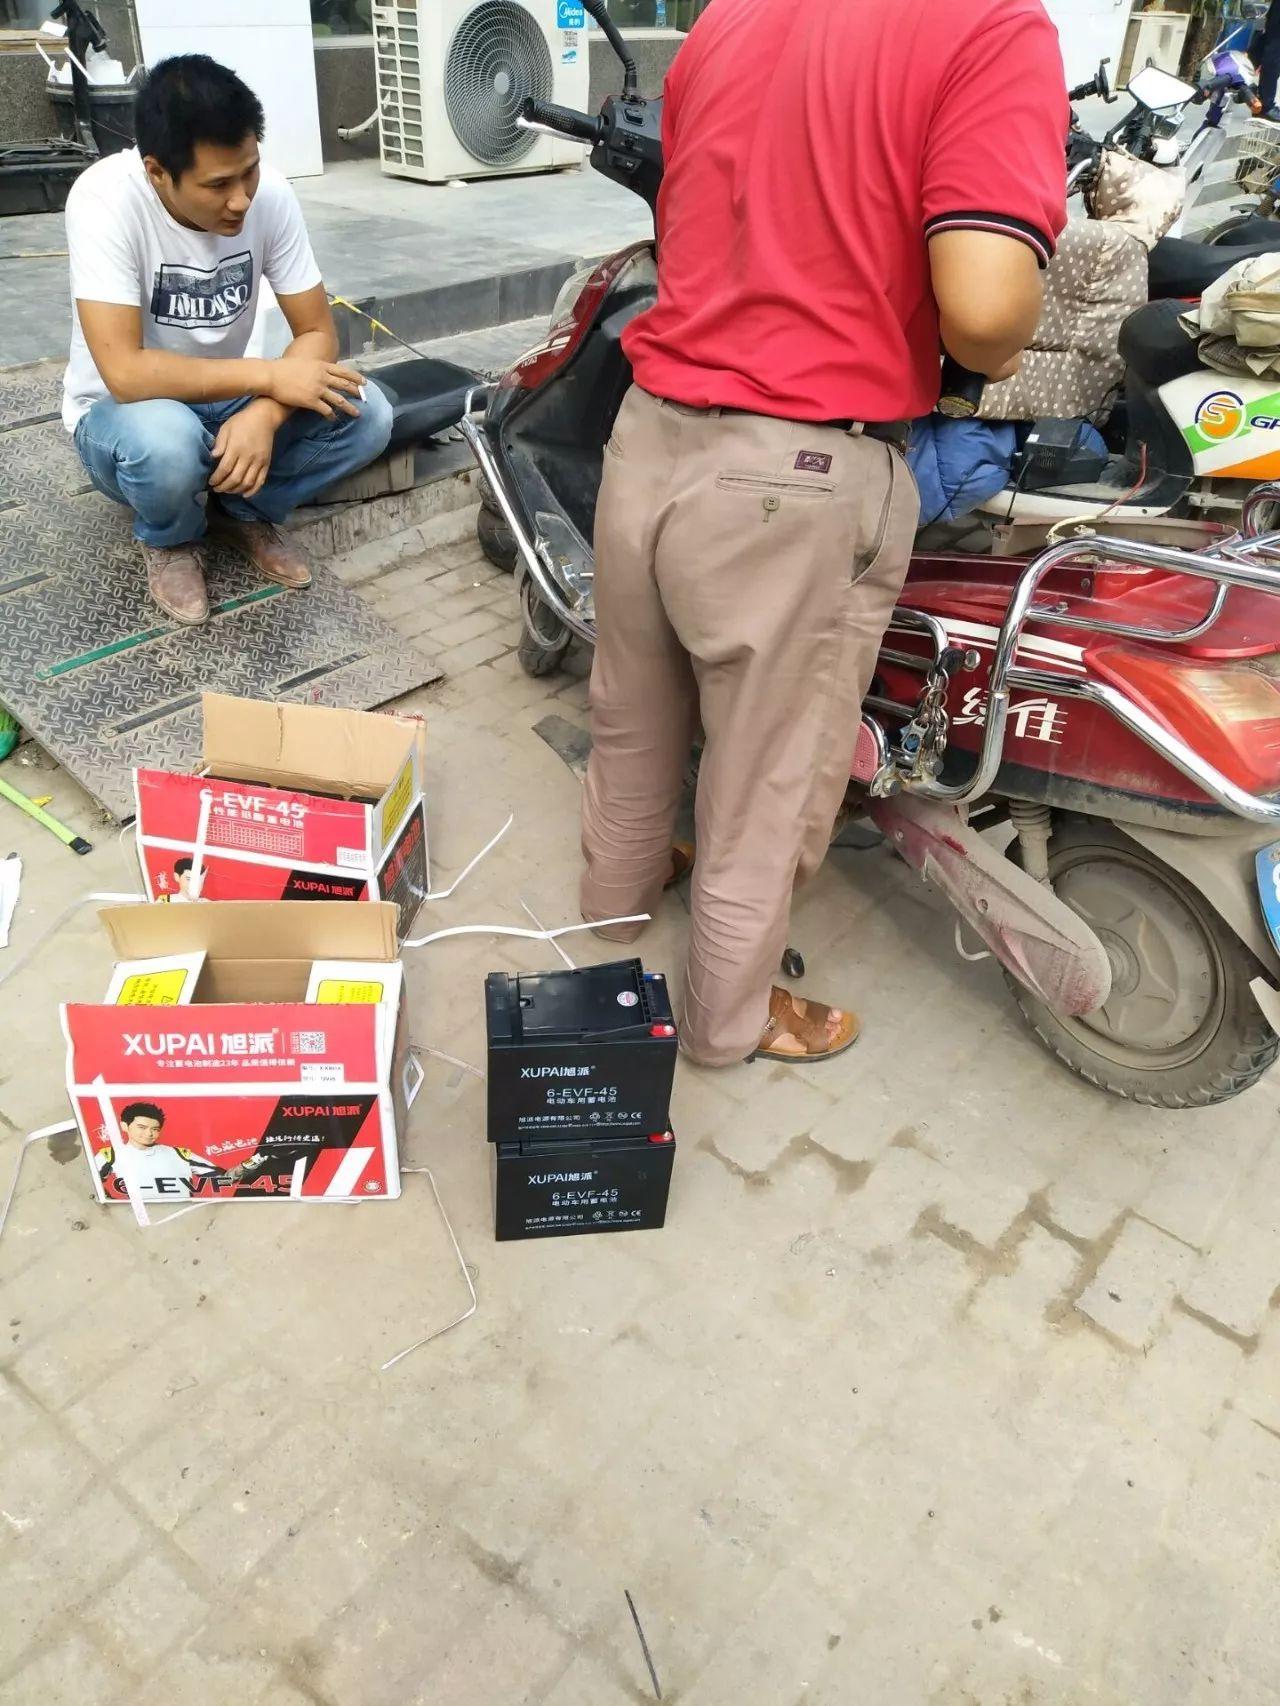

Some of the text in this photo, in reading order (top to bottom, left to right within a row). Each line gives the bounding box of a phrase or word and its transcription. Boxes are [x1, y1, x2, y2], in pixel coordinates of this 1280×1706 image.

[294, 880, 330, 893] XUPAI
[121, 1033, 275, 1056] XUPAI 旭派
[546, 1087, 618, 1098] 6-EVF-45
[546, 1096, 617, 1105] 电动车用蓄电池
[282, 1105, 361, 1117] XUPAI 旭派
[552, 1188, 619, 1200] 6-EVF-45
